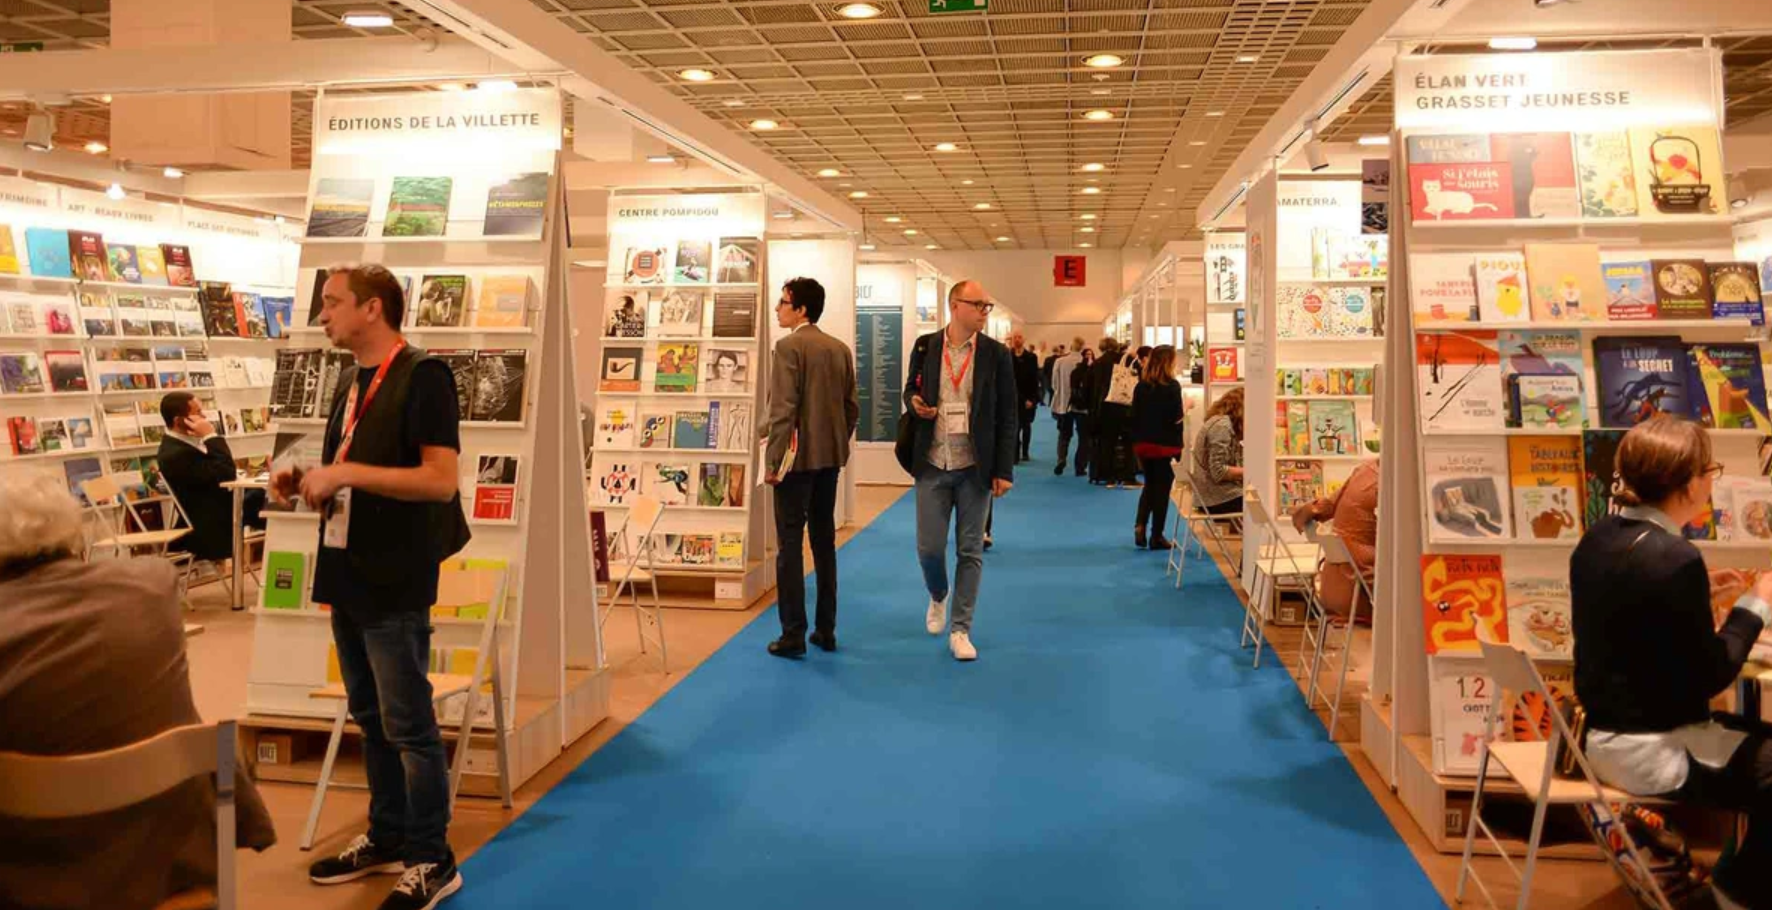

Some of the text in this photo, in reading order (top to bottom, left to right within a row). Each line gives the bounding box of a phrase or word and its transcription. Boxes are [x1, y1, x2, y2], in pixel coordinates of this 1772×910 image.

[1415, 72, 1527, 88] ÉLAN VERT
[1416, 91, 1630, 109] GRASSET JEUNESSE
[328, 113, 540, 131] ÉDITIONS DE LA VILLETTE
[0, 192, 48, 207] TRIMOINE
[618, 207, 719, 217] CENTRE POMPIDOU
[1064, 259, 1077, 278] E
[1638, 359, 1673, 373] SECRET
